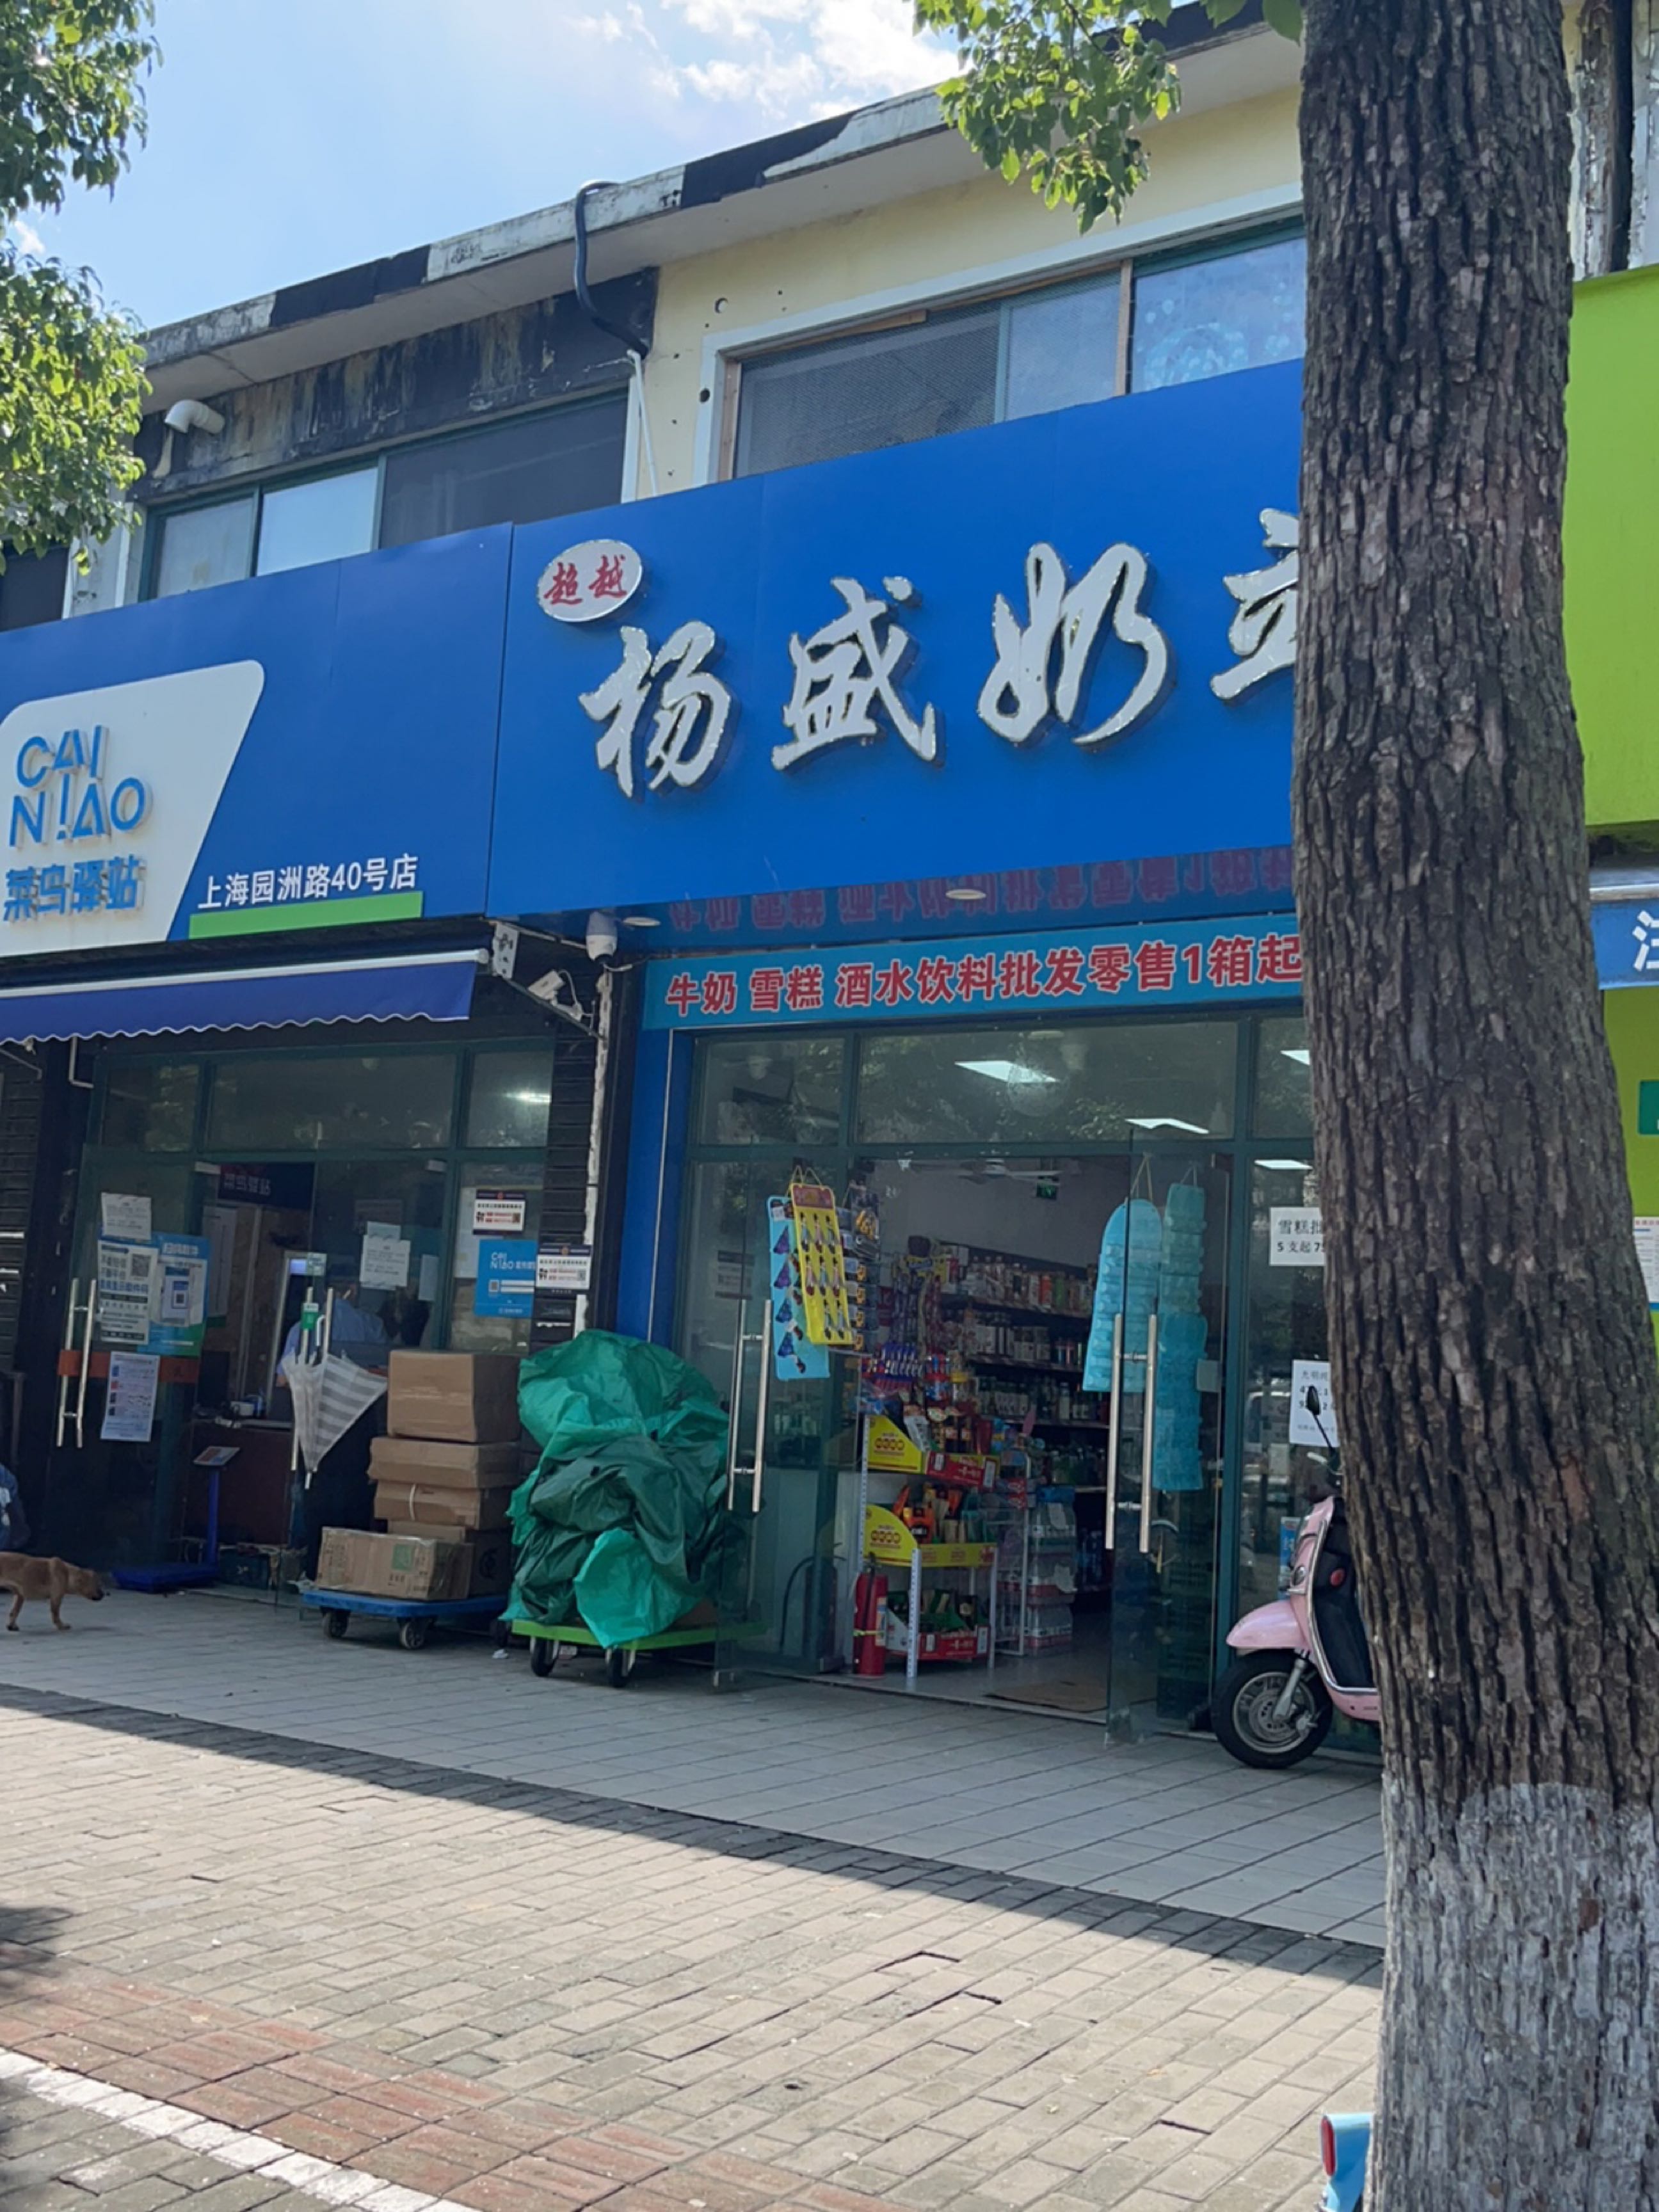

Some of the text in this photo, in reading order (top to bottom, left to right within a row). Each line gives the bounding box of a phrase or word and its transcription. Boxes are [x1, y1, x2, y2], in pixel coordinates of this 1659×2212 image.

[17, 725, 106, 788] CAI
[9, 773, 151, 847] NIAO
[3, 854, 143, 924] 菜鸟驿站
[197, 853, 419, 910] 上海园洲路40号店
[666, 934, 1302, 1016] 牛奶 雪糕 酒水饮料批发零售1箱起
